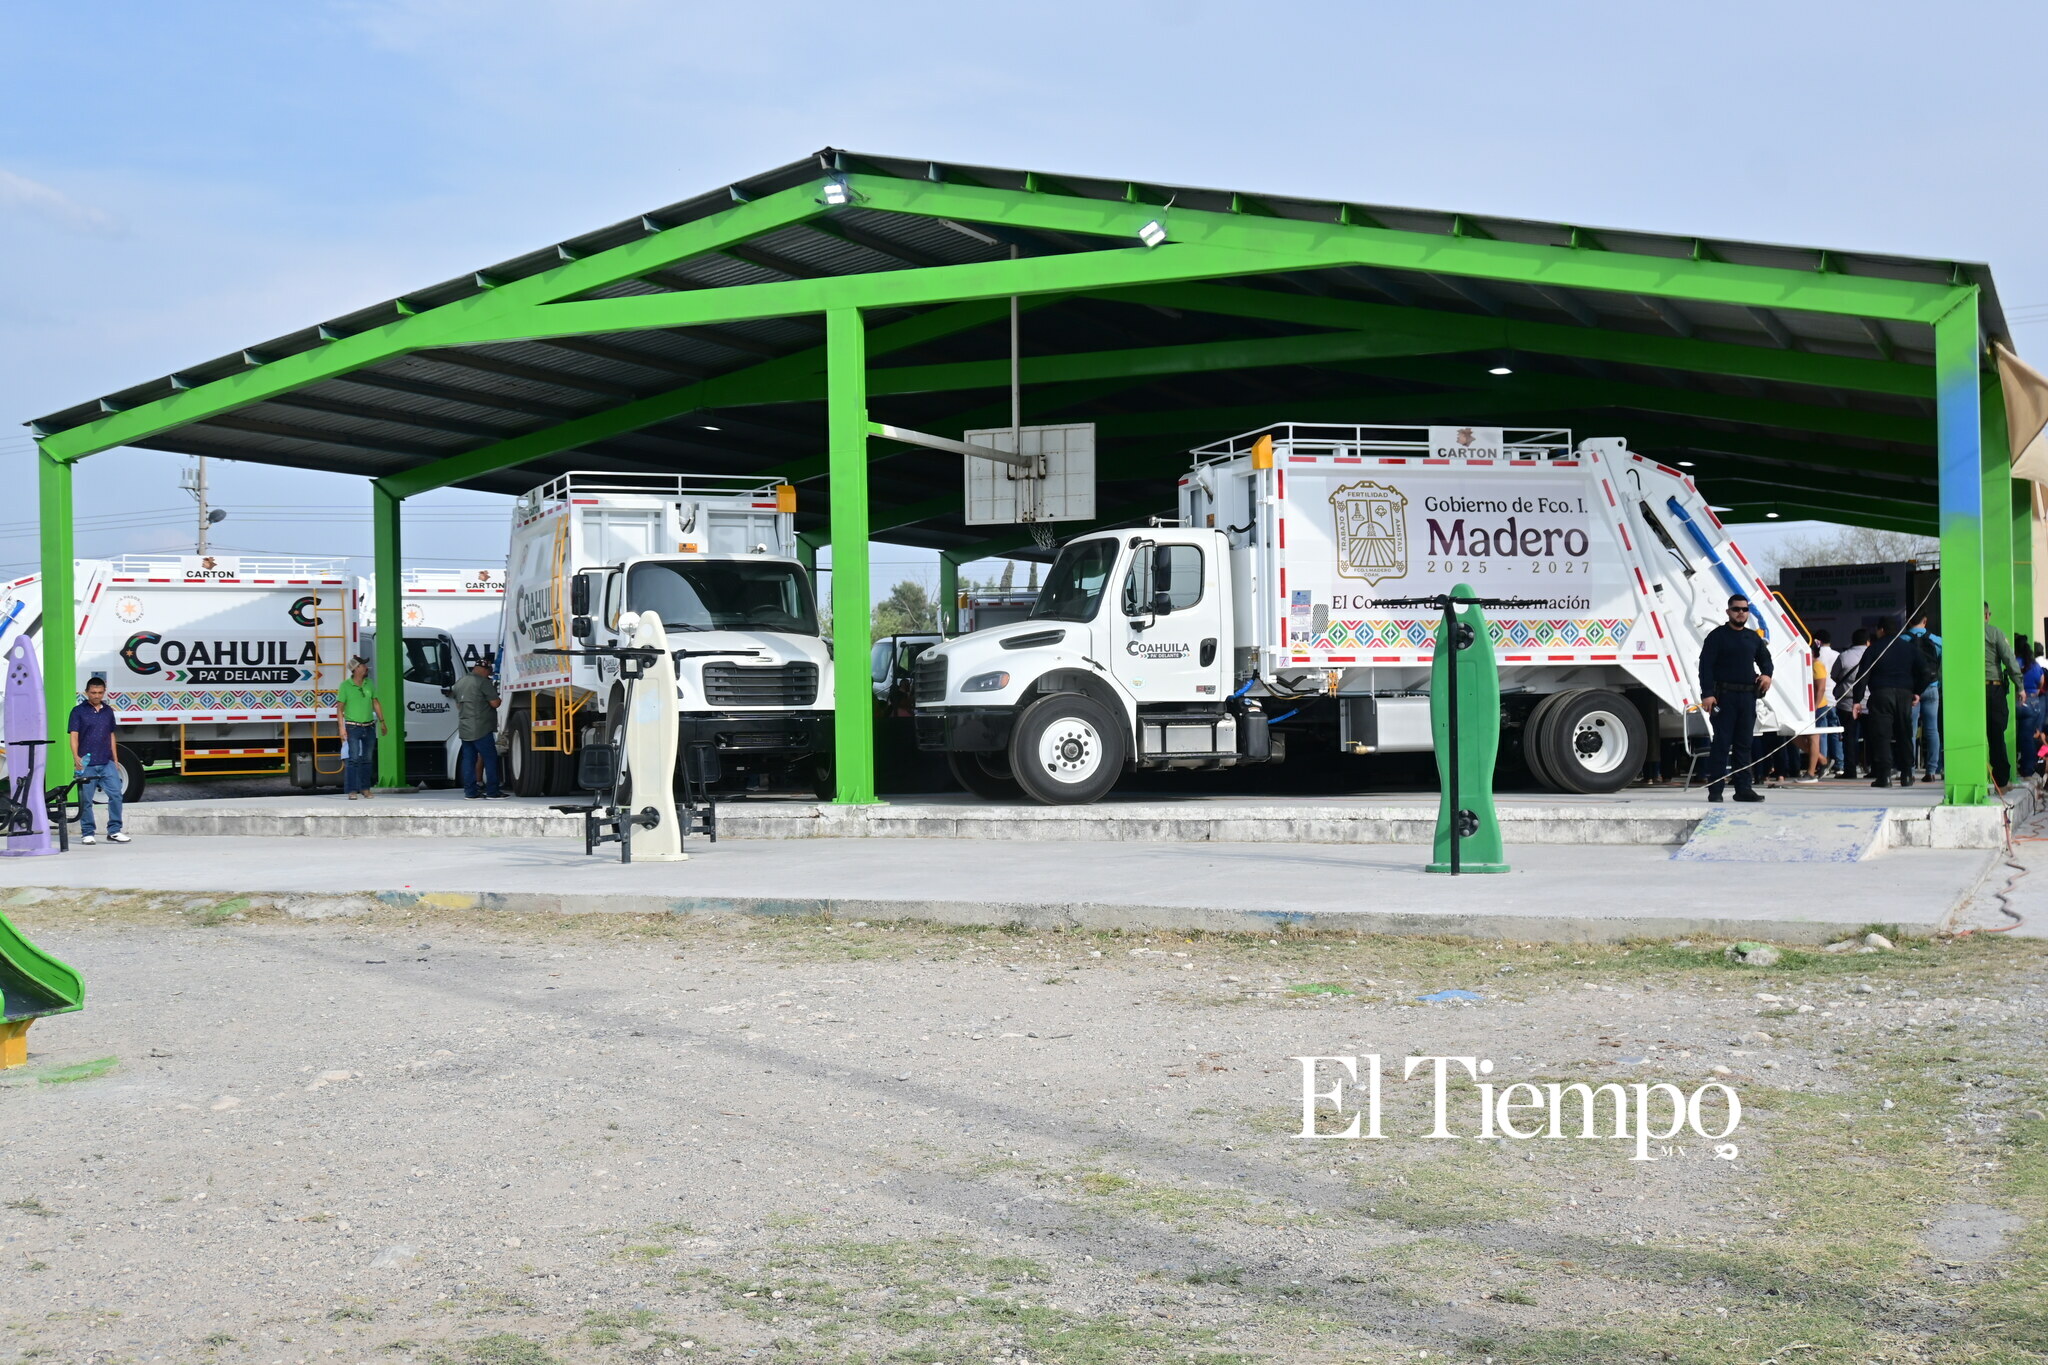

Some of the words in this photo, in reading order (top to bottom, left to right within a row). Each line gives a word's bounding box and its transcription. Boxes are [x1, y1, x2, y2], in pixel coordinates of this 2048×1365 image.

[1438, 448, 1497, 458] CARTON
[1424, 496, 1508, 513] Gobierno
[1512, 497, 1534, 514] de
[1538, 498, 1573, 514] Fco.
[1426, 516, 1589, 557] Madero
[1427, 561, 1487, 574] 2025
[1532, 561, 1590, 574] 2027
[1801, 570, 1834, 578] ENTREGA
[1846, 566, 1884, 576] CAMIONES
[1862, 576, 1891, 584] BASURA
[1332, 595, 1347, 610] El
[119, 630, 323, 675] COAHUILA
[1126, 640, 1190, 656] COAHUILA
[224, 670, 288, 680] DELANTE
[407, 701, 450, 712] COAHUILA
